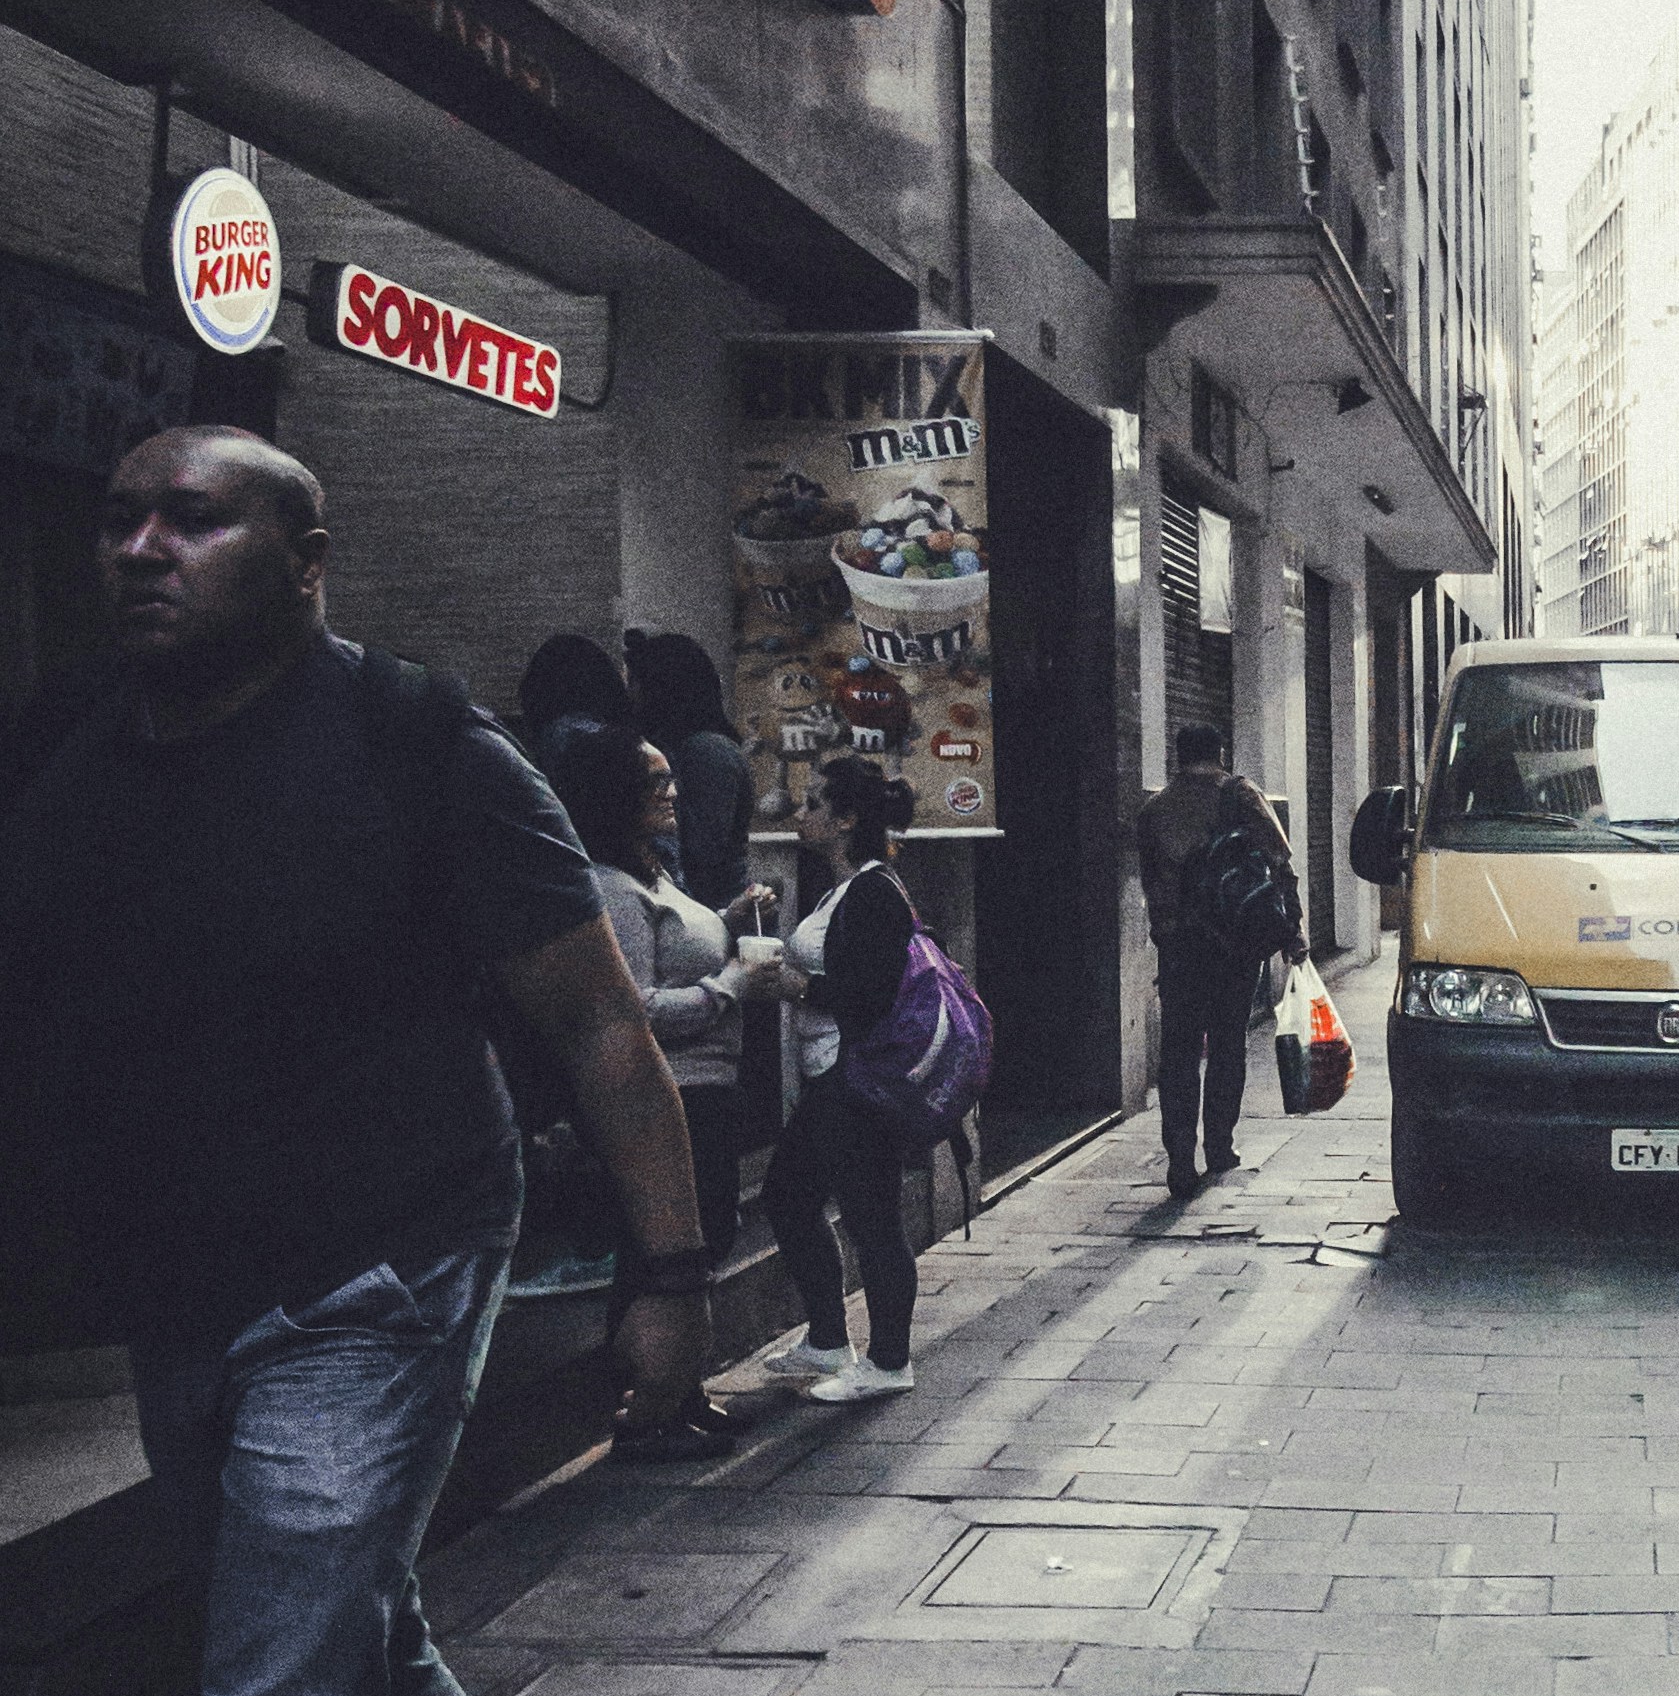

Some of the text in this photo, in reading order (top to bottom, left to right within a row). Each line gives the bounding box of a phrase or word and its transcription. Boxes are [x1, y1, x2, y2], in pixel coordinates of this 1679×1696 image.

[195, 220, 269, 255] BURGER
[194, 251, 271, 301] KING
[344, 273, 557, 411] SORVETES
[846, 353, 971, 418] MIX
